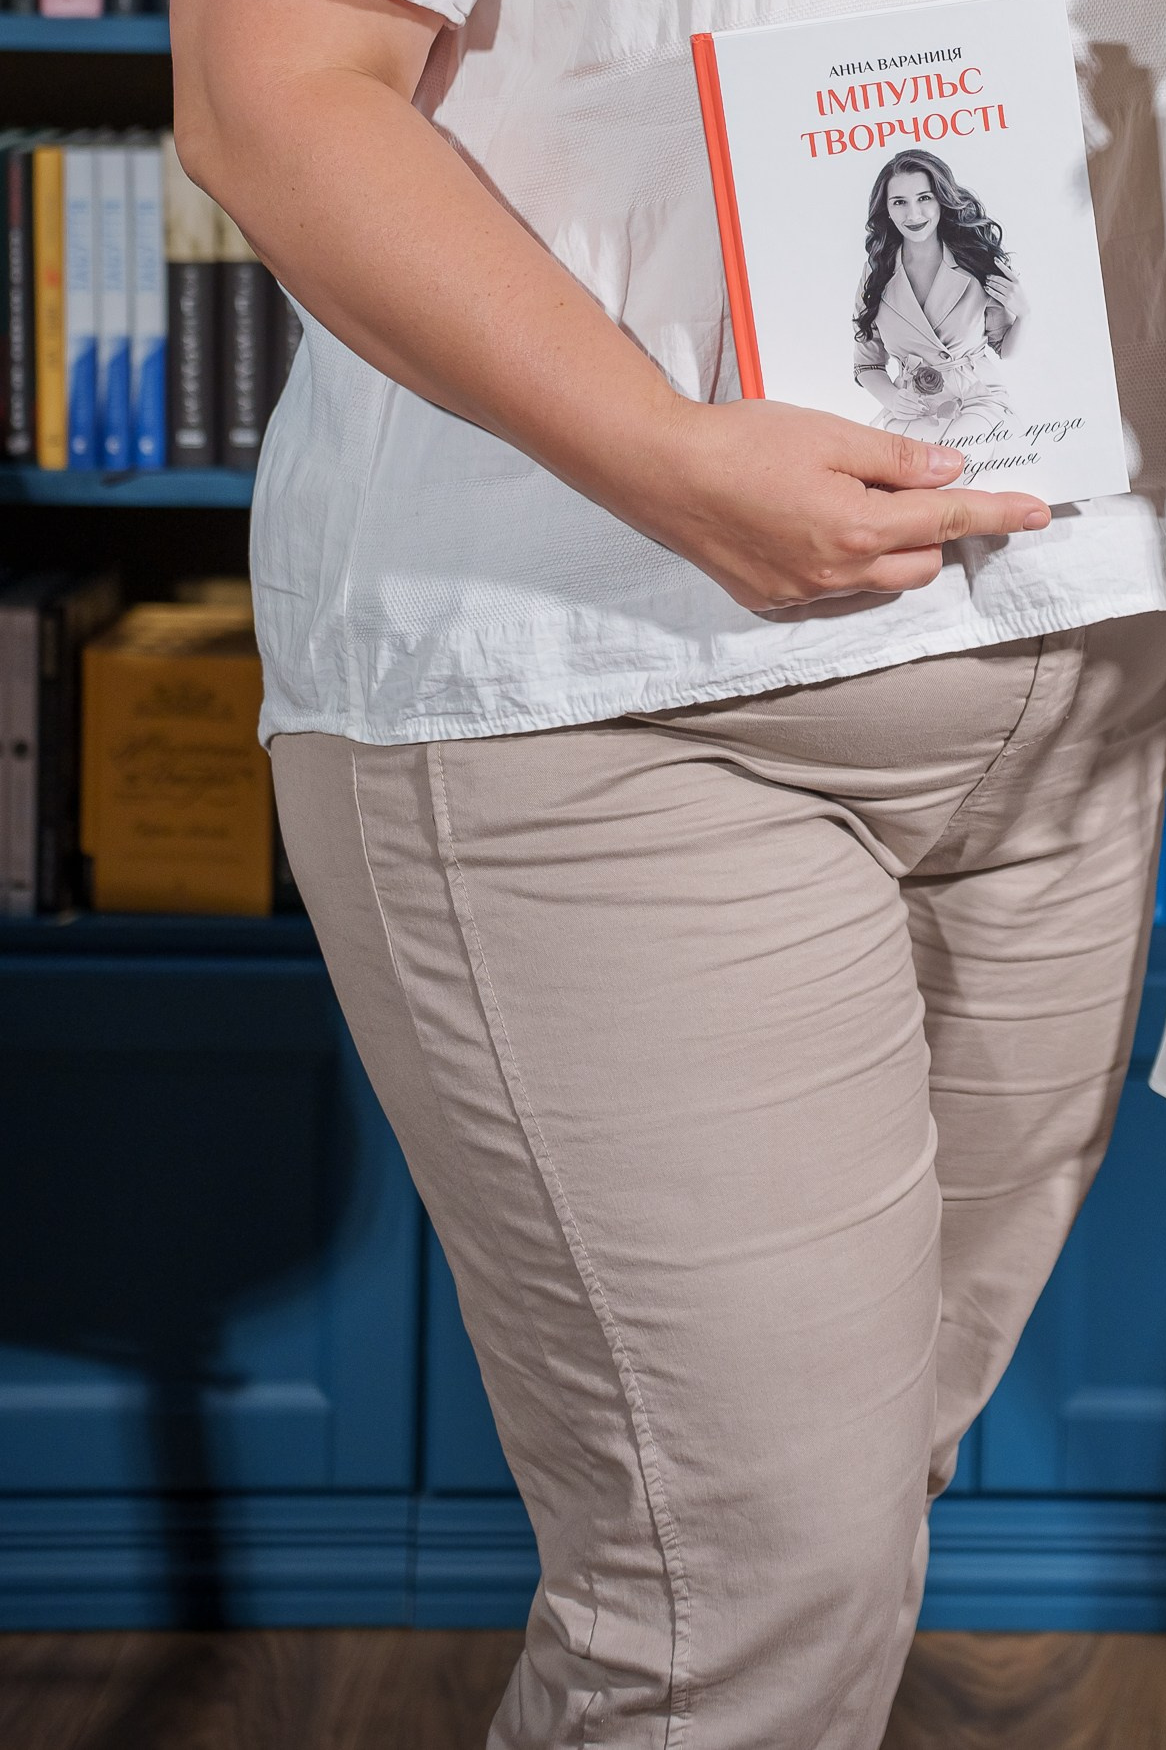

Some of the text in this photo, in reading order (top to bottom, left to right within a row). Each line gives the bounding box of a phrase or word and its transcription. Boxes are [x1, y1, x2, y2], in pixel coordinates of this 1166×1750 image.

[829, 47, 962, 78] АННА ВАРАНИЦЯ
[816, 67, 984, 116] ІМПУЛЬС
[800, 104, 1009, 158] ТВОРЧОСТІ
[932, 417, 1086, 449] ттєва проза
